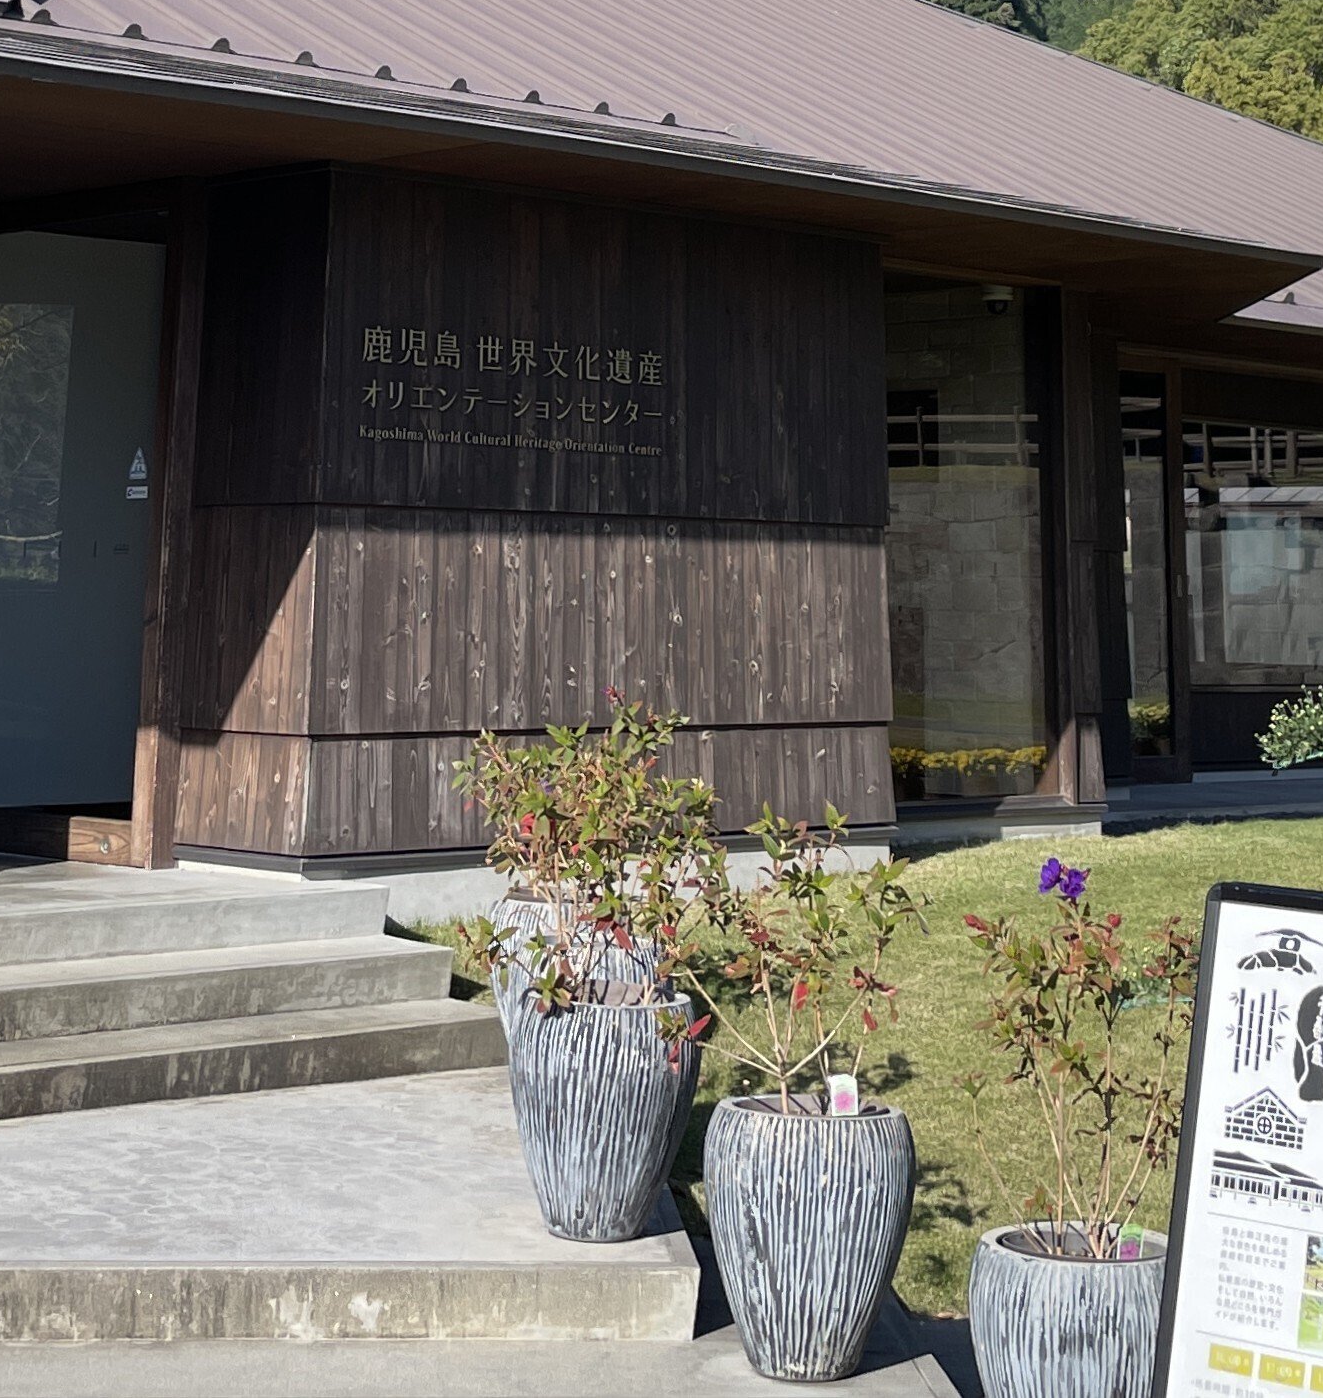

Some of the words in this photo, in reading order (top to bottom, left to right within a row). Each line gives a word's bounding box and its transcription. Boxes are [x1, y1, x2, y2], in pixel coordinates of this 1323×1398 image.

[361, 325, 462, 370] 鹿児島
[477, 335, 664, 387] 世界文化遺産
[361, 379, 663, 427] オリエンテーションセンター
[359, 425, 424, 442] Kagoshima
[427, 429, 461, 443] World
[464, 432, 511, 448] Cultural
[515, 436, 562, 453] Heritage
[564, 438, 625, 454] Orientation
[629, 442, 662, 456] Centre
